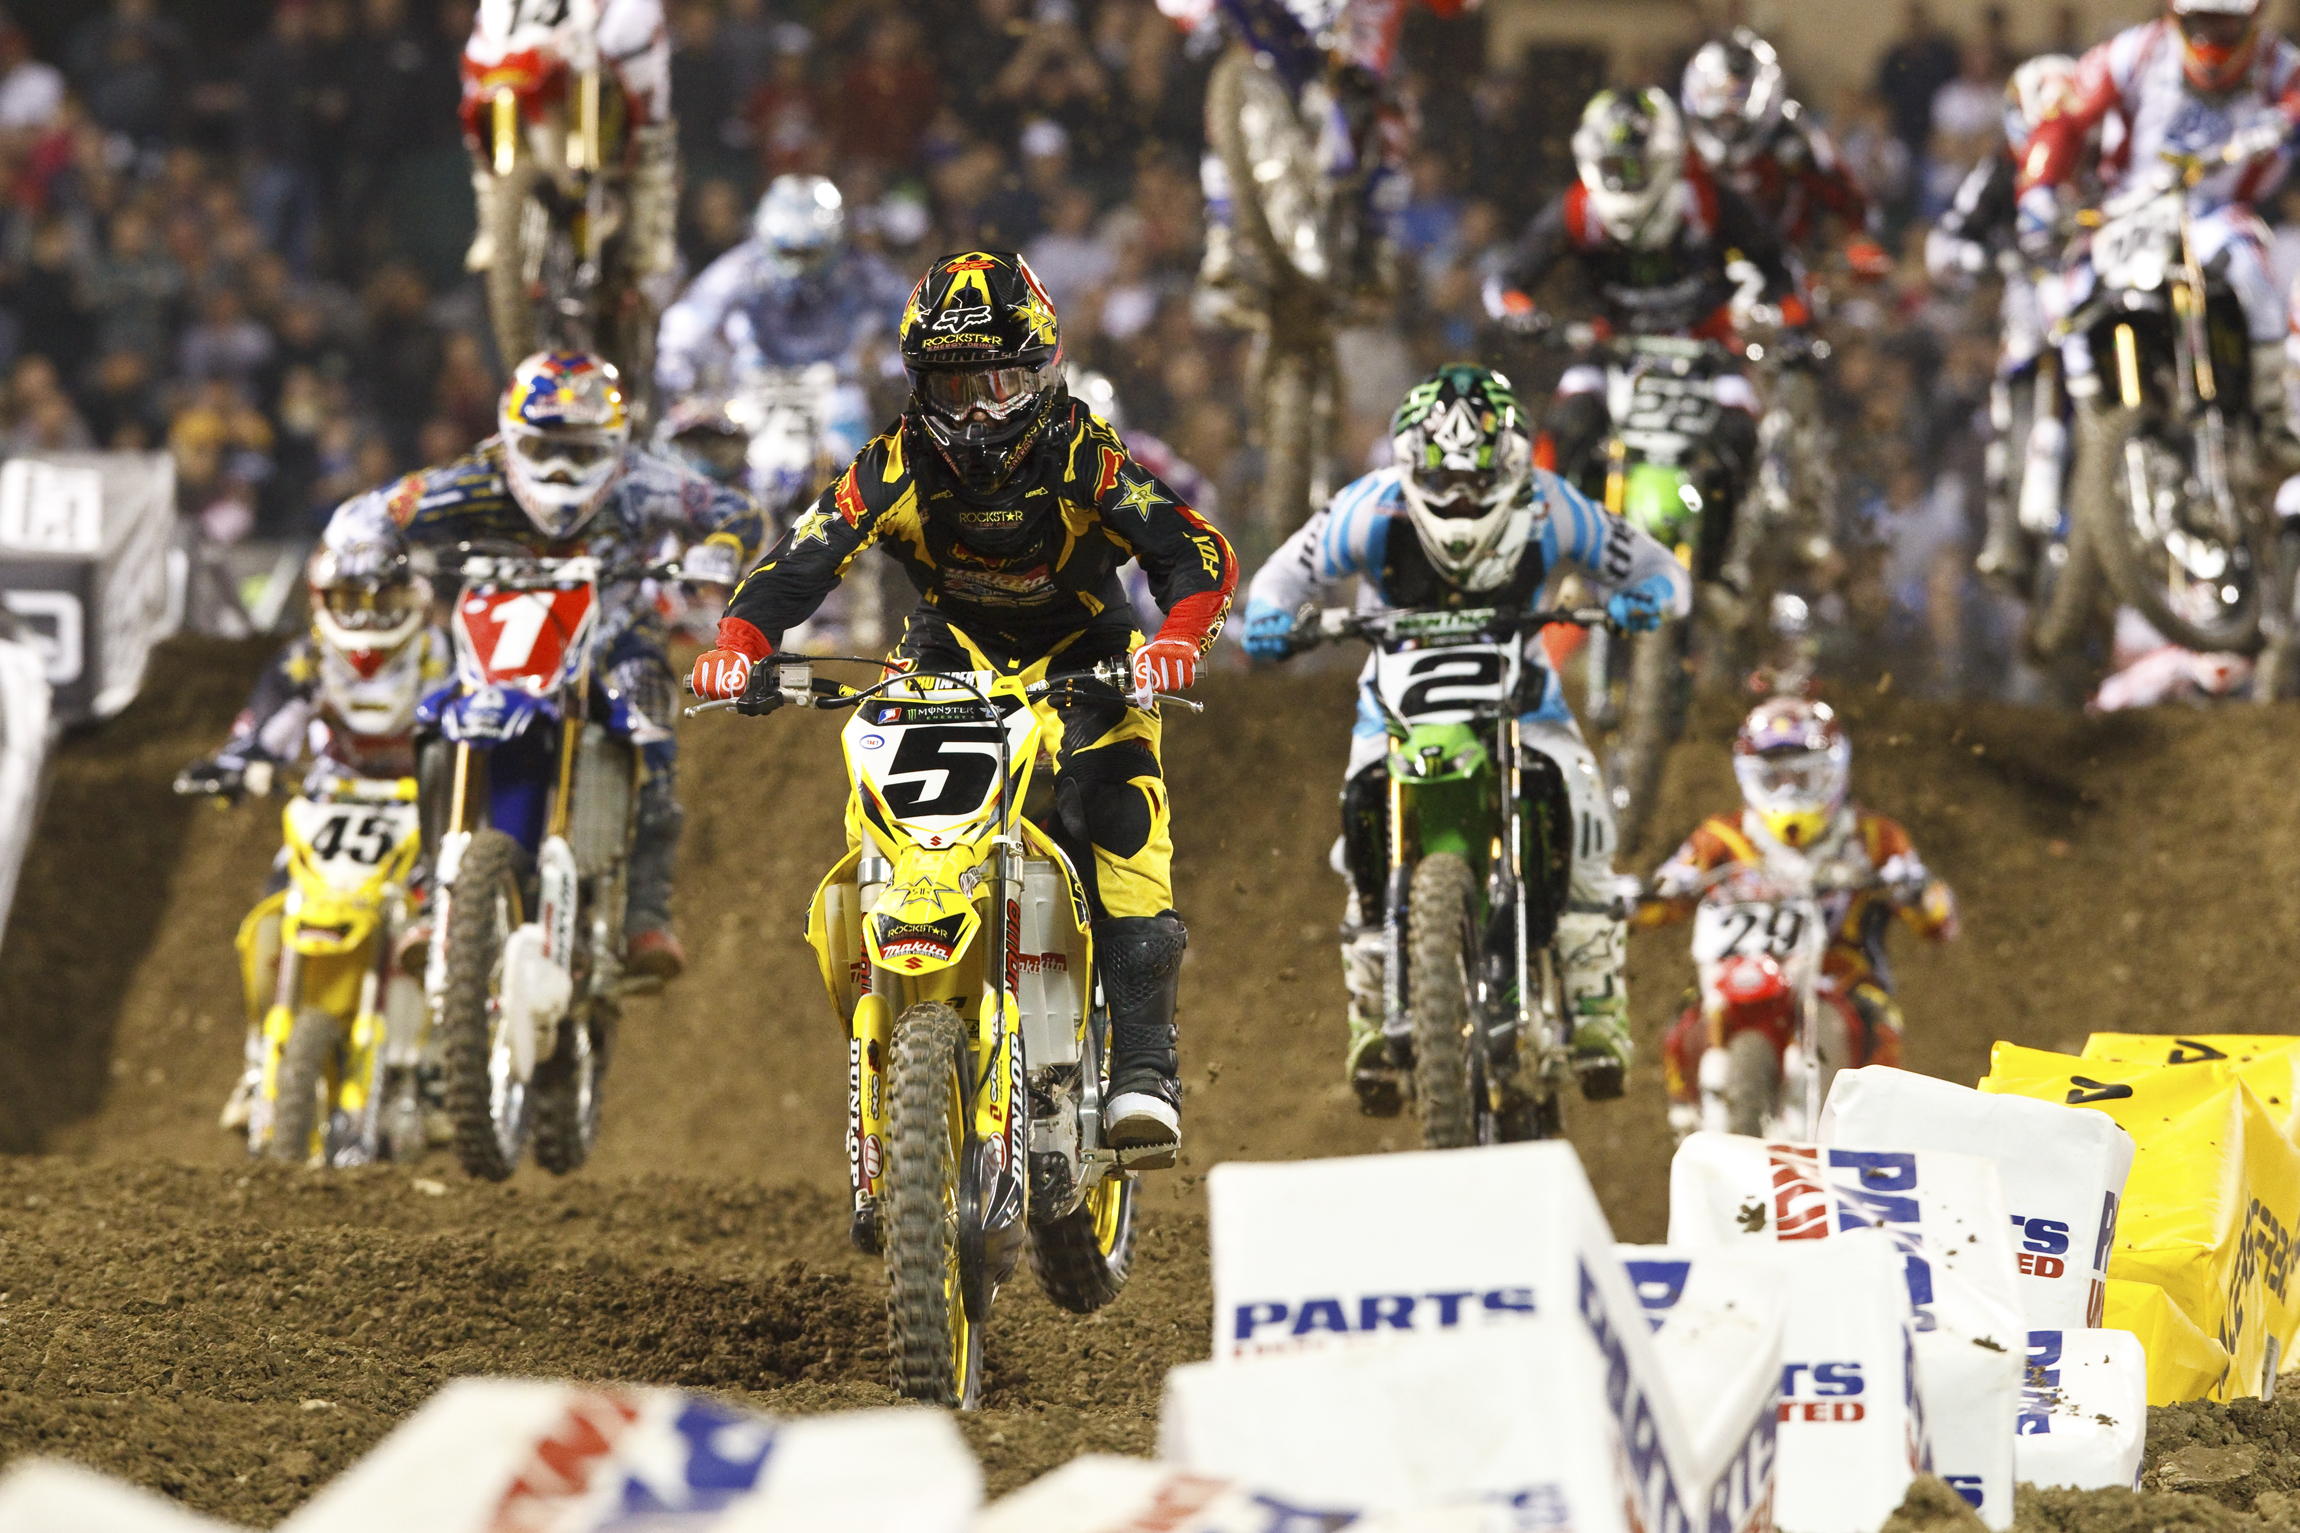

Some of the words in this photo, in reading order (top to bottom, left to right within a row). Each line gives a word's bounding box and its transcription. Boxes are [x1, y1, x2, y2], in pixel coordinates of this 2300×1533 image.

[489, 591, 557, 671] 1
[1400, 652, 1509, 718] 2
[882, 726, 1012, 820] 5
[312, 816, 398, 864] 45
[1718, 910, 1803, 961] 29
[1234, 1286, 1536, 1340] PARTS
